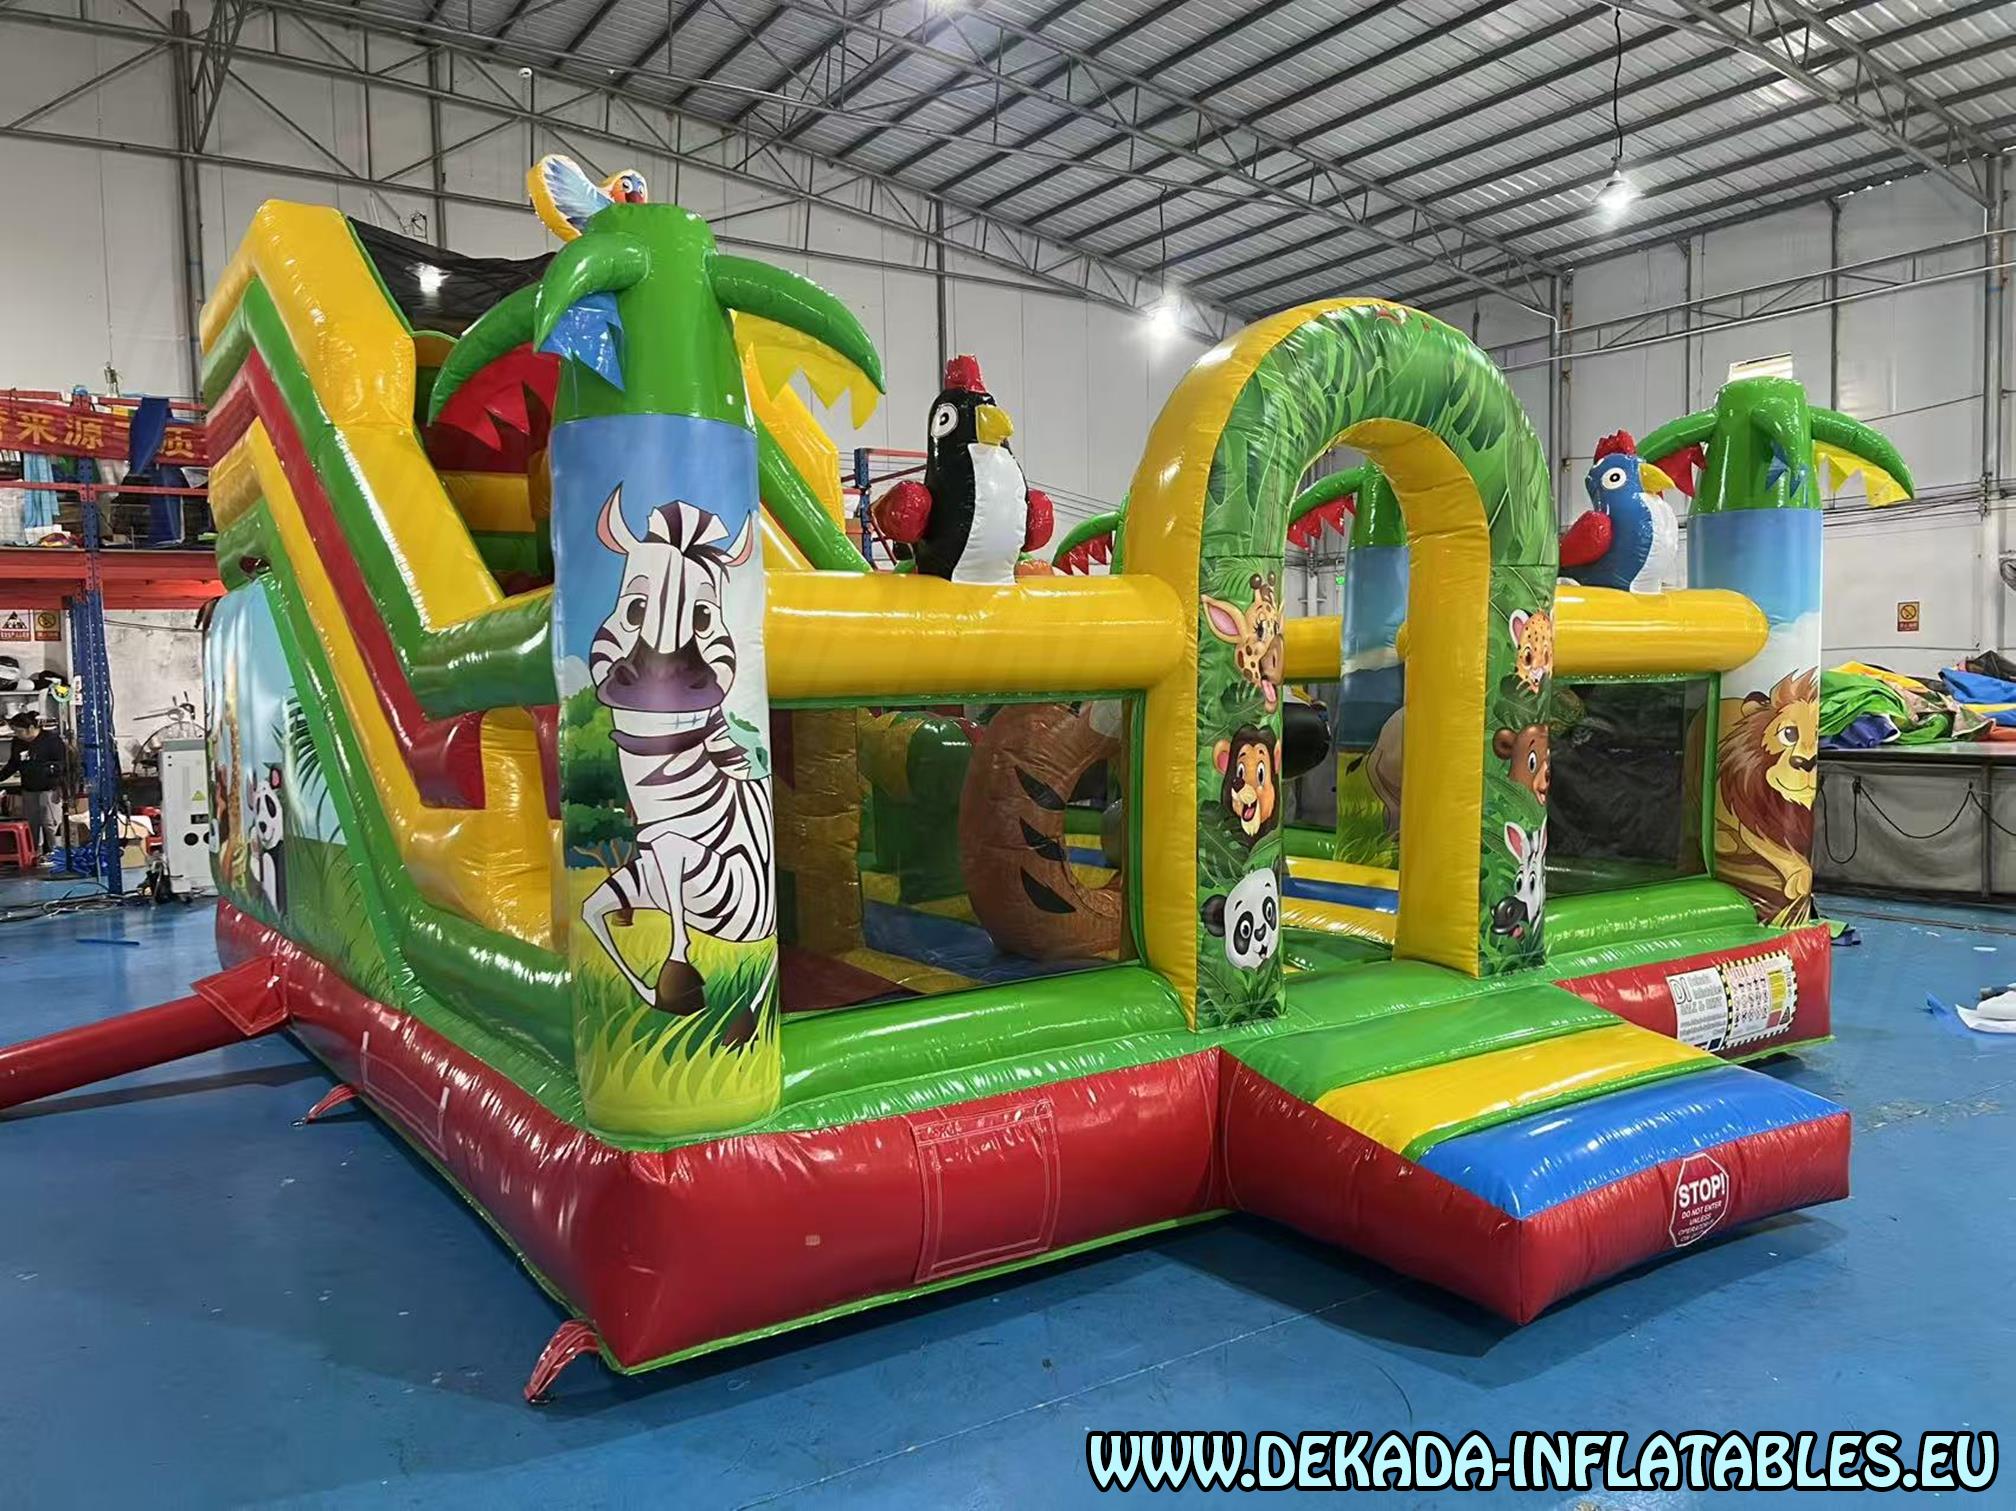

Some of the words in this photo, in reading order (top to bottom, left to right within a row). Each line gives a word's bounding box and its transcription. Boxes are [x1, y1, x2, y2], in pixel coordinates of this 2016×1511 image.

[1669, 976, 1692, 1005] DI
[1678, 1172, 1725, 1208] STOP!
[1681, 1210, 1691, 1219] DO
[1691, 1206, 1704, 1216] NOT
